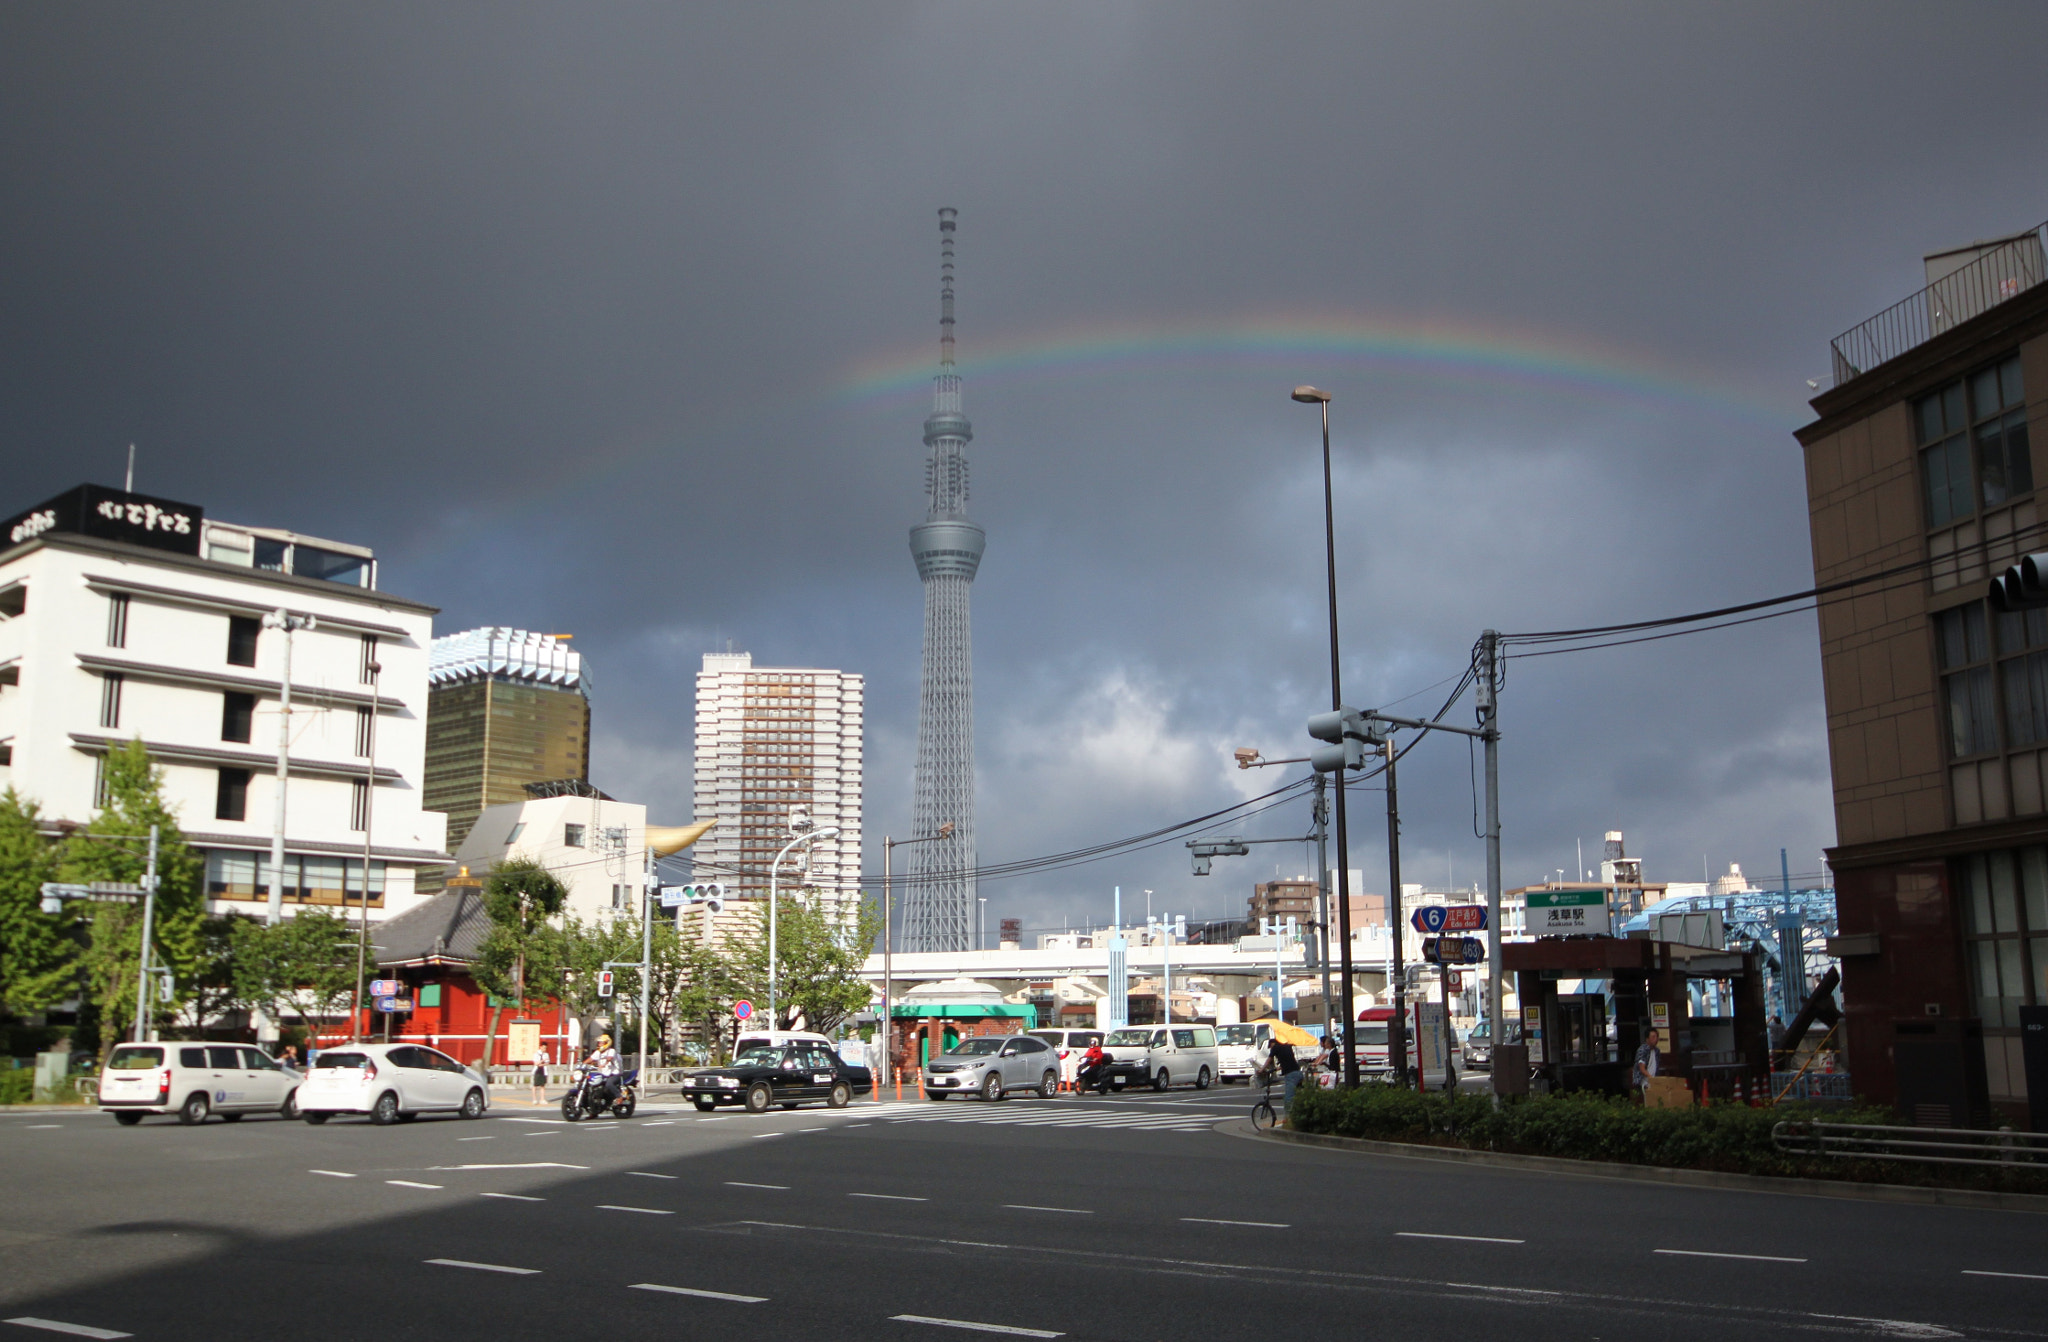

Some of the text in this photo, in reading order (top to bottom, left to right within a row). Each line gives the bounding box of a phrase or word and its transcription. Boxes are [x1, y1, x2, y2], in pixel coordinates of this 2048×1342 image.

[1429, 909, 1440, 926] 6
[1449, 909, 1477, 921] 江戸通り
[1548, 908, 1584, 921] 浅草駅
[1462, 943, 1478, 958] 463
